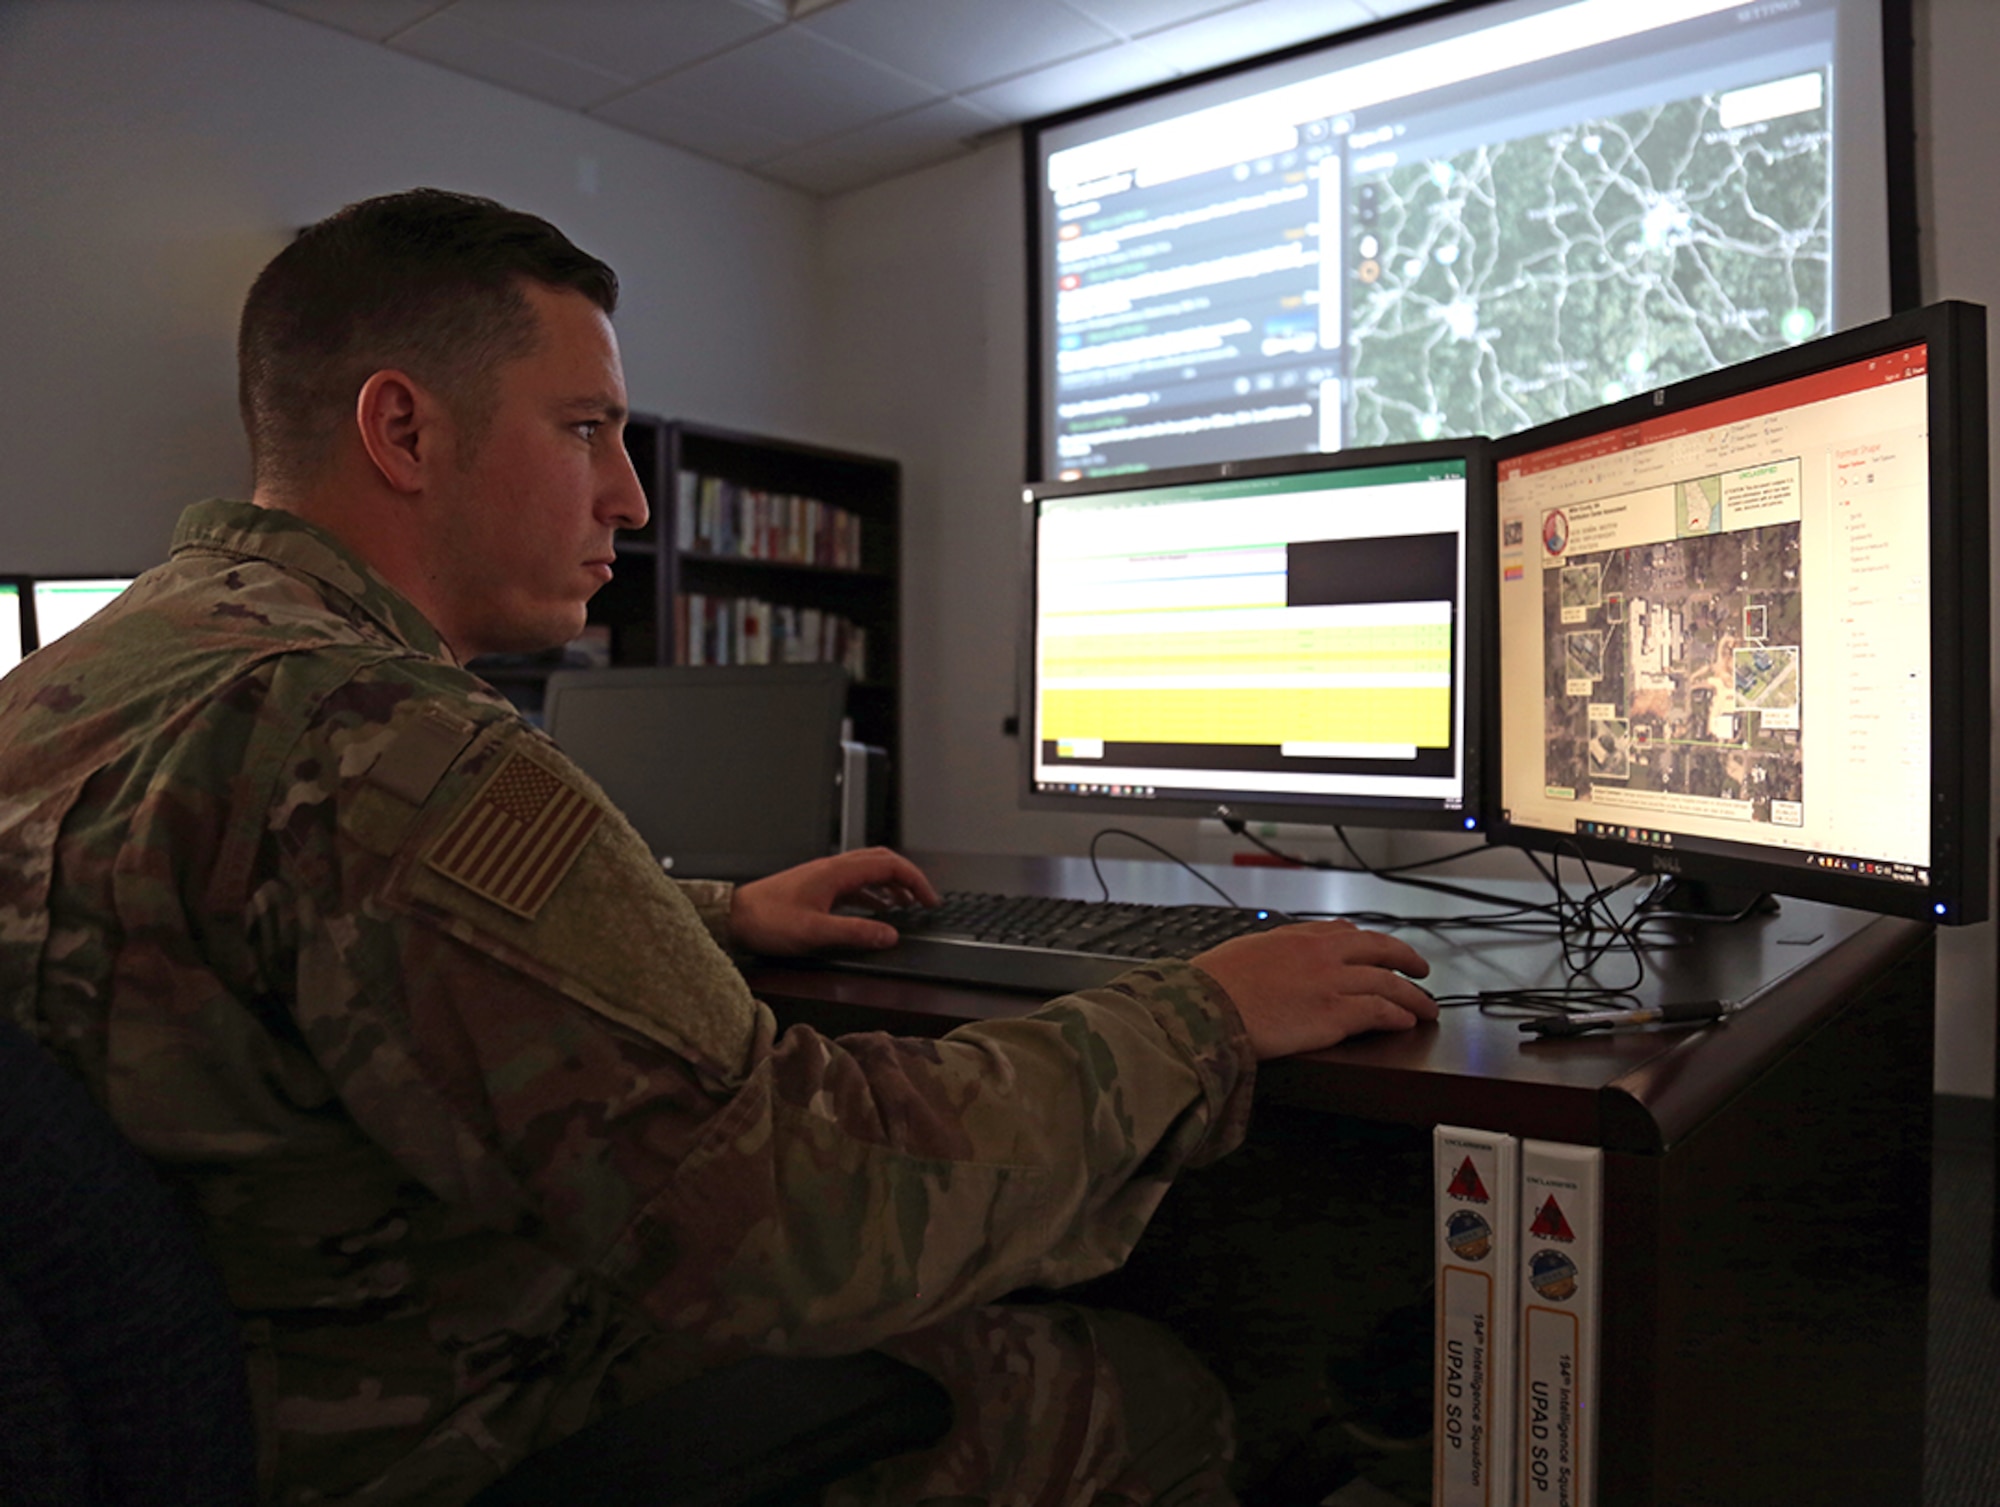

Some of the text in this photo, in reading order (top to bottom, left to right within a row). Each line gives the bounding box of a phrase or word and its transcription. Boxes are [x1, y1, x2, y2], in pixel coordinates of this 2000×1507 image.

[1446, 1340, 1463, 1449] UPAD SOP
[1470, 1347, 1483, 1422] Intelligence
[1470, 1425, 1483, 1487] Squadron
[1531, 1381, 1549, 1492] UPAD SOP
[1557, 1388, 1571, 1463] Intelligence
